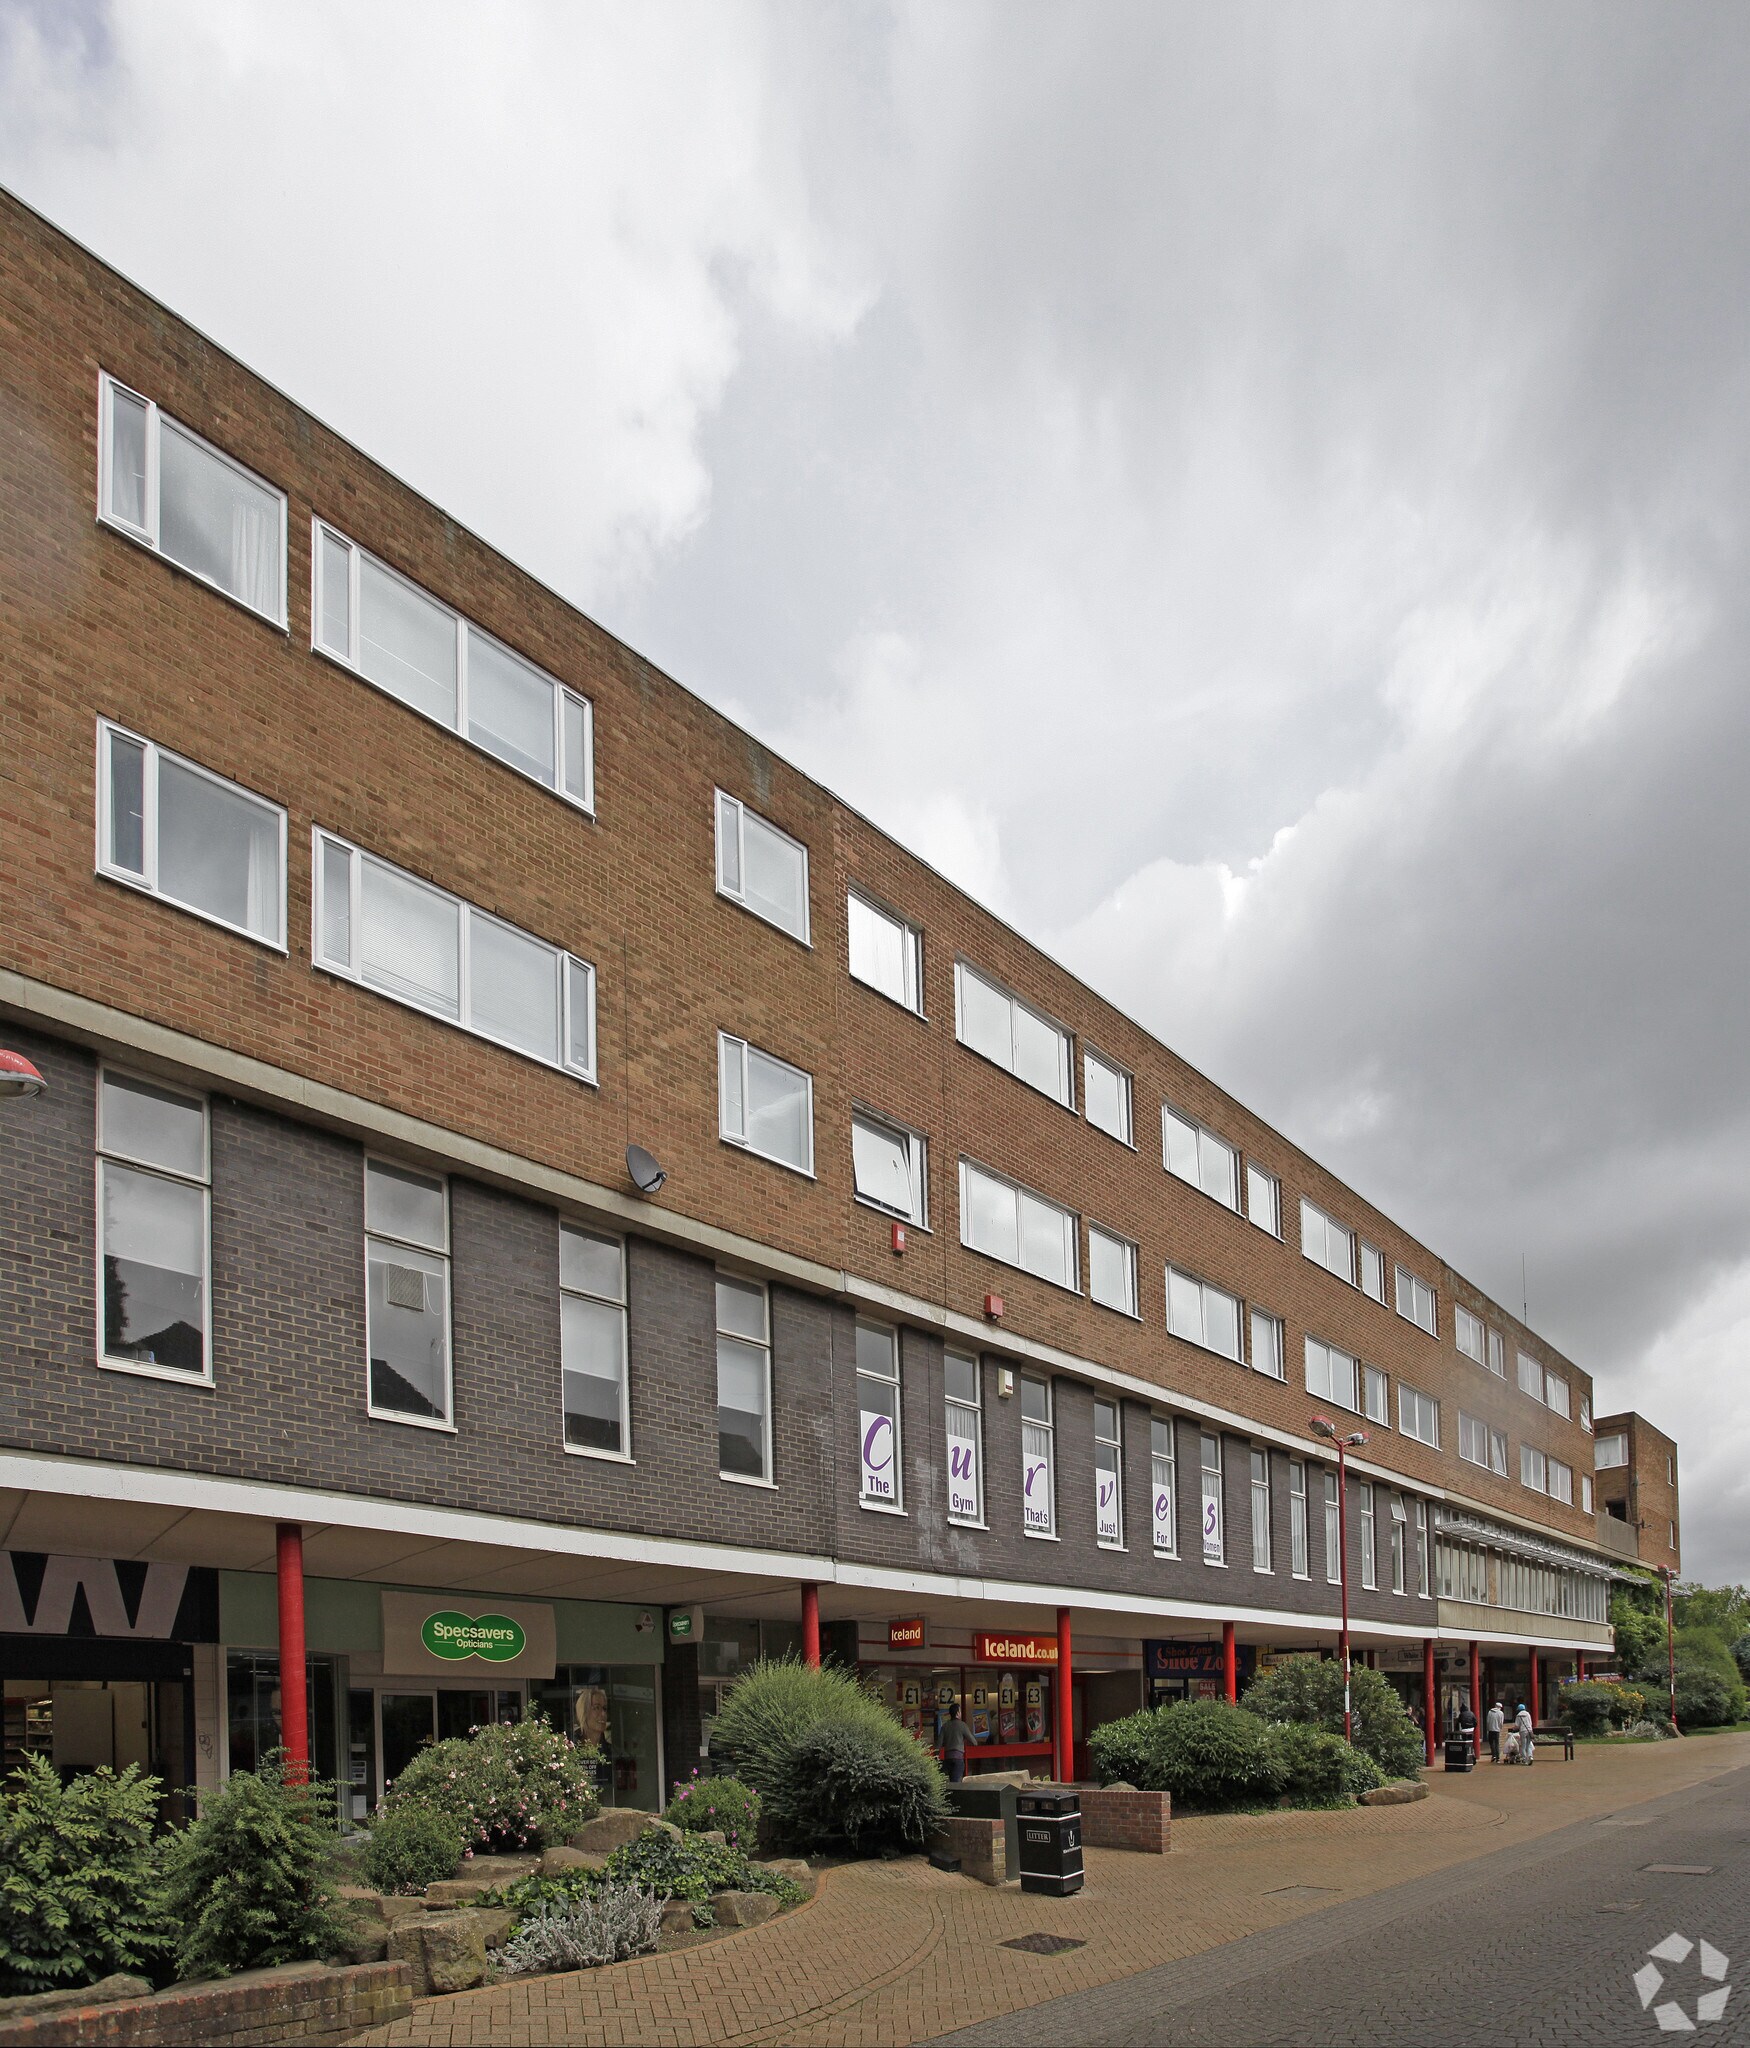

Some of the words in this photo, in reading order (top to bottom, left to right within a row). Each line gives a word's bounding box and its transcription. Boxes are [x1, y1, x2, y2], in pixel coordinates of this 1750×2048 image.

[863, 1416, 891, 1471] C
[868, 1475, 889, 1493] The
[953, 1493, 973, 1513] Gym
[1025, 1507, 1048, 1525] That's
[1100, 1520, 1116, 1535] Just
[1156, 1531, 1168, 1544] For
[433, 1622, 514, 1640] Specsavers
[891, 1627, 921, 1641] Iceland
[456, 1639, 494, 1649] Opticians
[1166, 1646, 1187, 1656] Shoe
[1189, 1645, 1213, 1656] Zone
[1200, 1683, 1216, 1691] SALE
[905, 1688, 919, 1704] £1
[939, 1688, 954, 1704] £2
[974, 1688, 986, 1704] £1
[1002, 1688, 1014, 1704] £1
[1028, 1688, 1040, 1704] £3
[1028, 1832, 1049, 1841] LITTER
